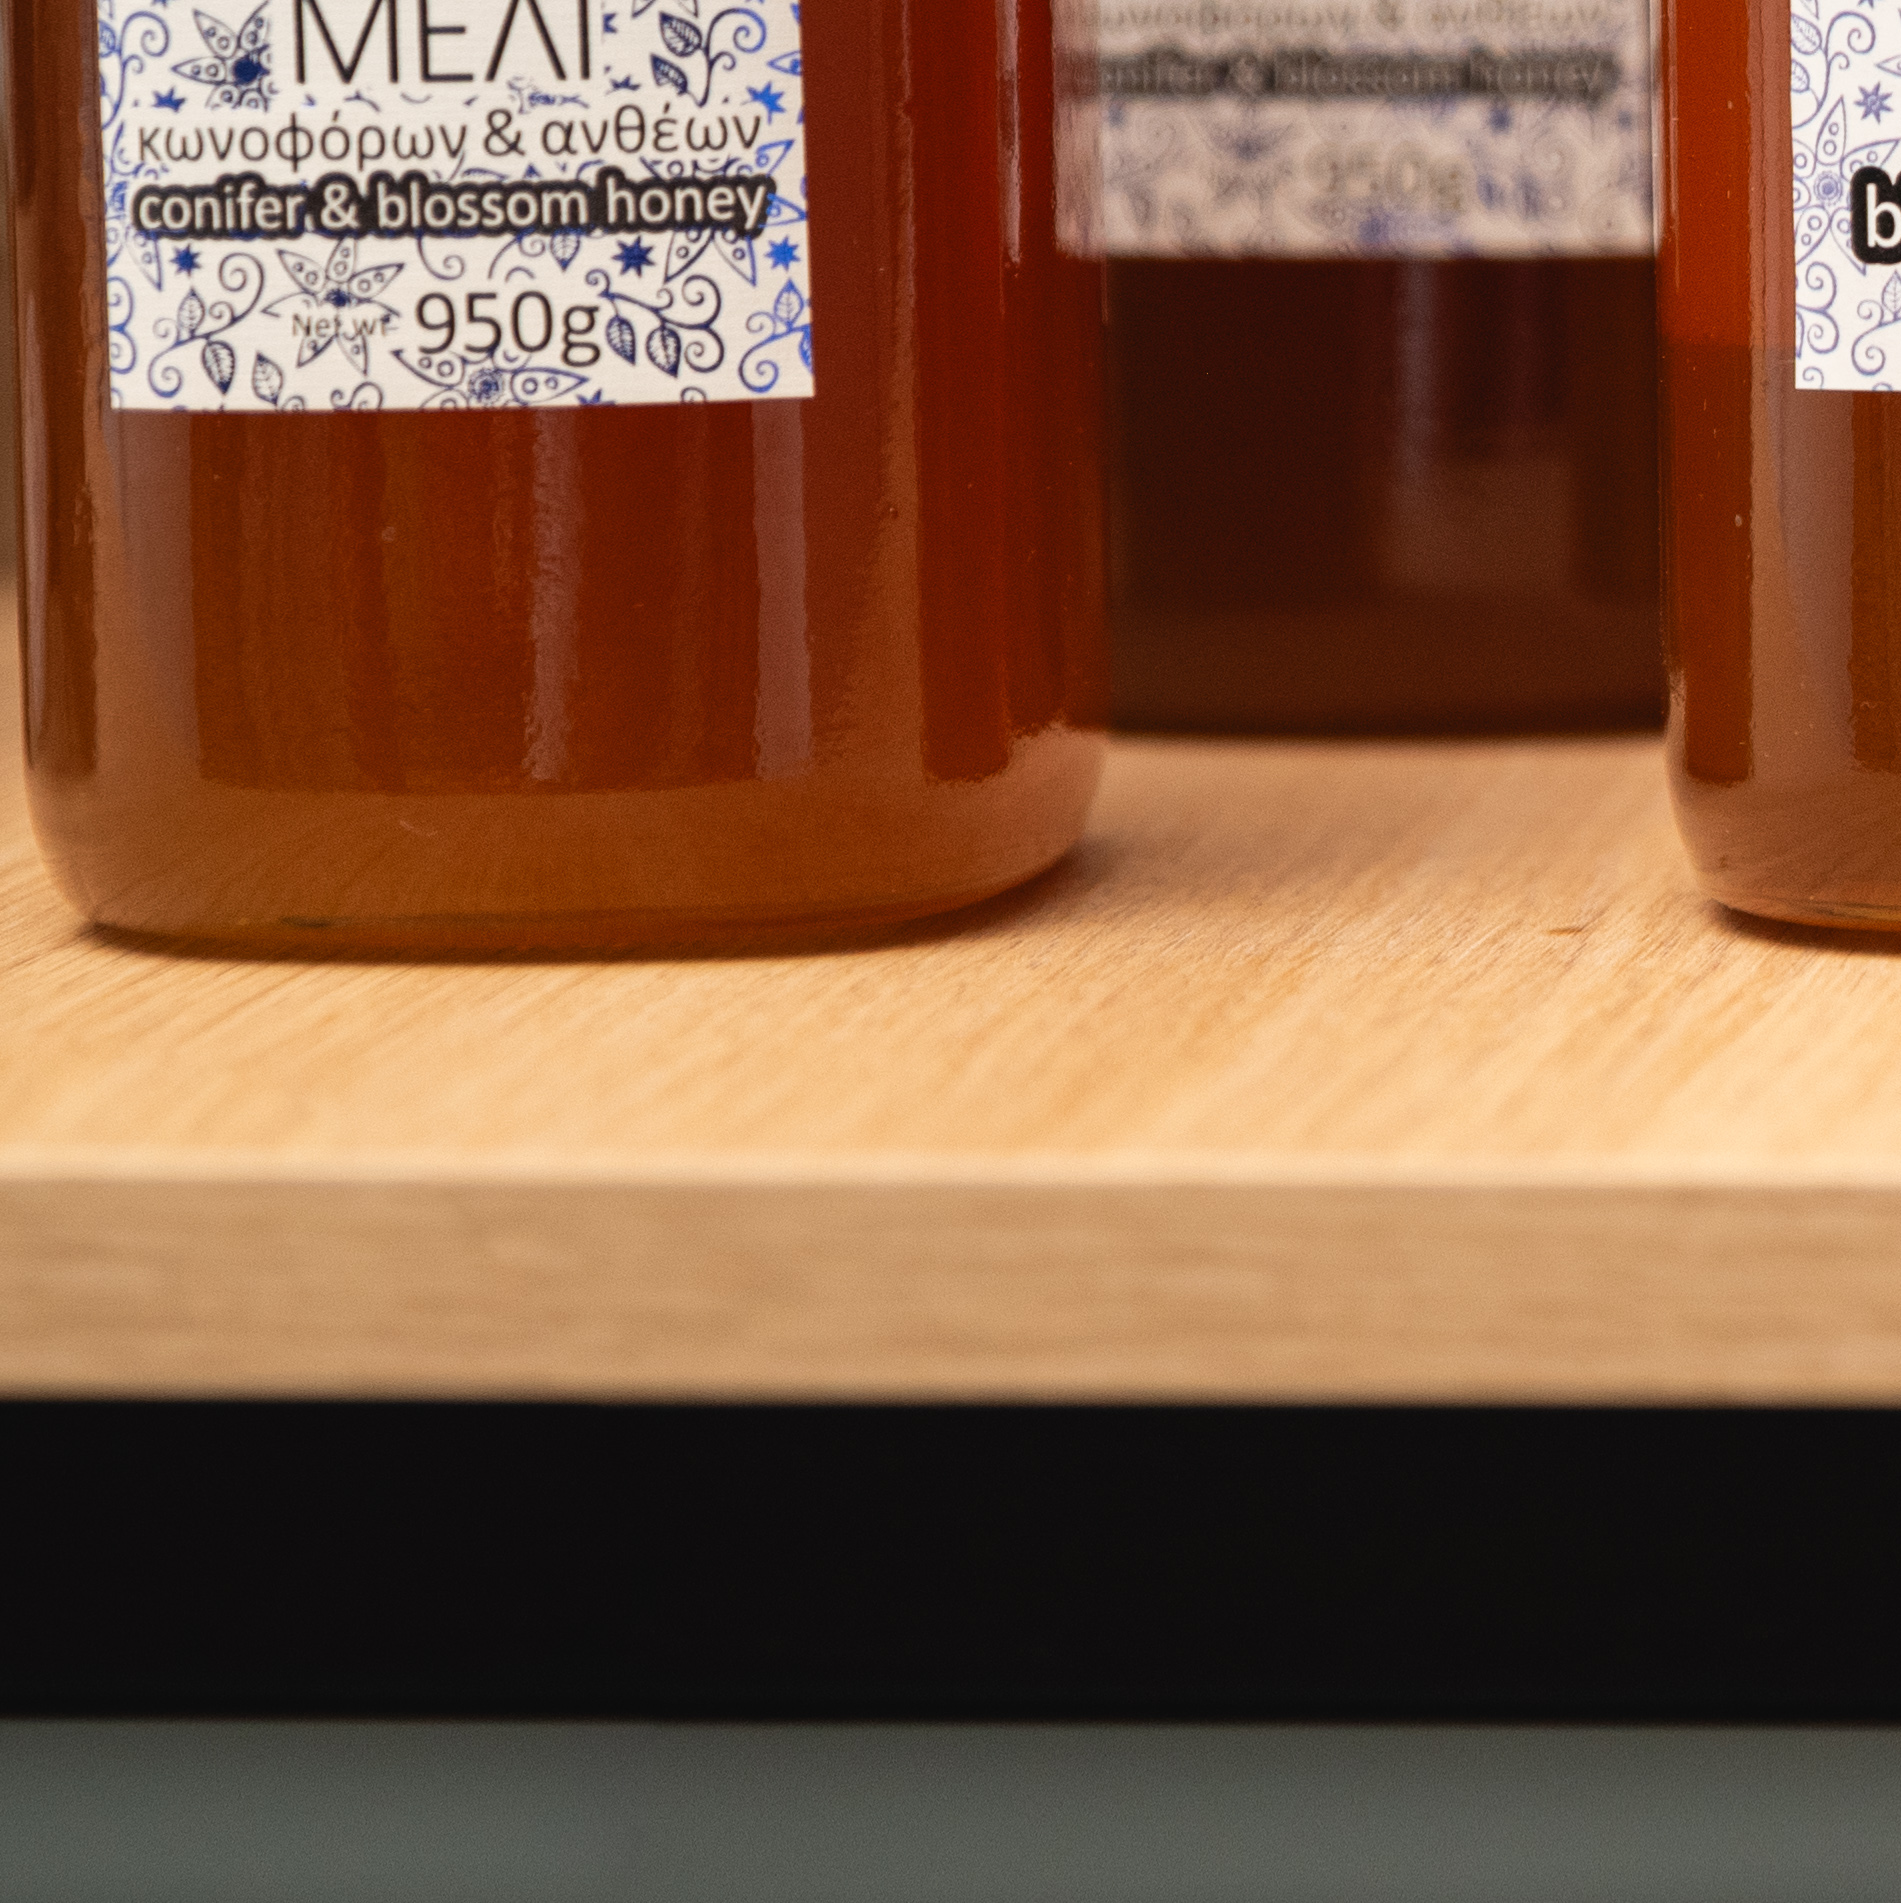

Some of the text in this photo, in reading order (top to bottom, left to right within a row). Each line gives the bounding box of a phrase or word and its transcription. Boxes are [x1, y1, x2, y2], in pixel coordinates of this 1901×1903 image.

[139, 104, 761, 172] κωνοφόρων & ανθέων
[138, 174, 768, 231] conifer & blossom honey
[417, 291, 601, 366] 950g
